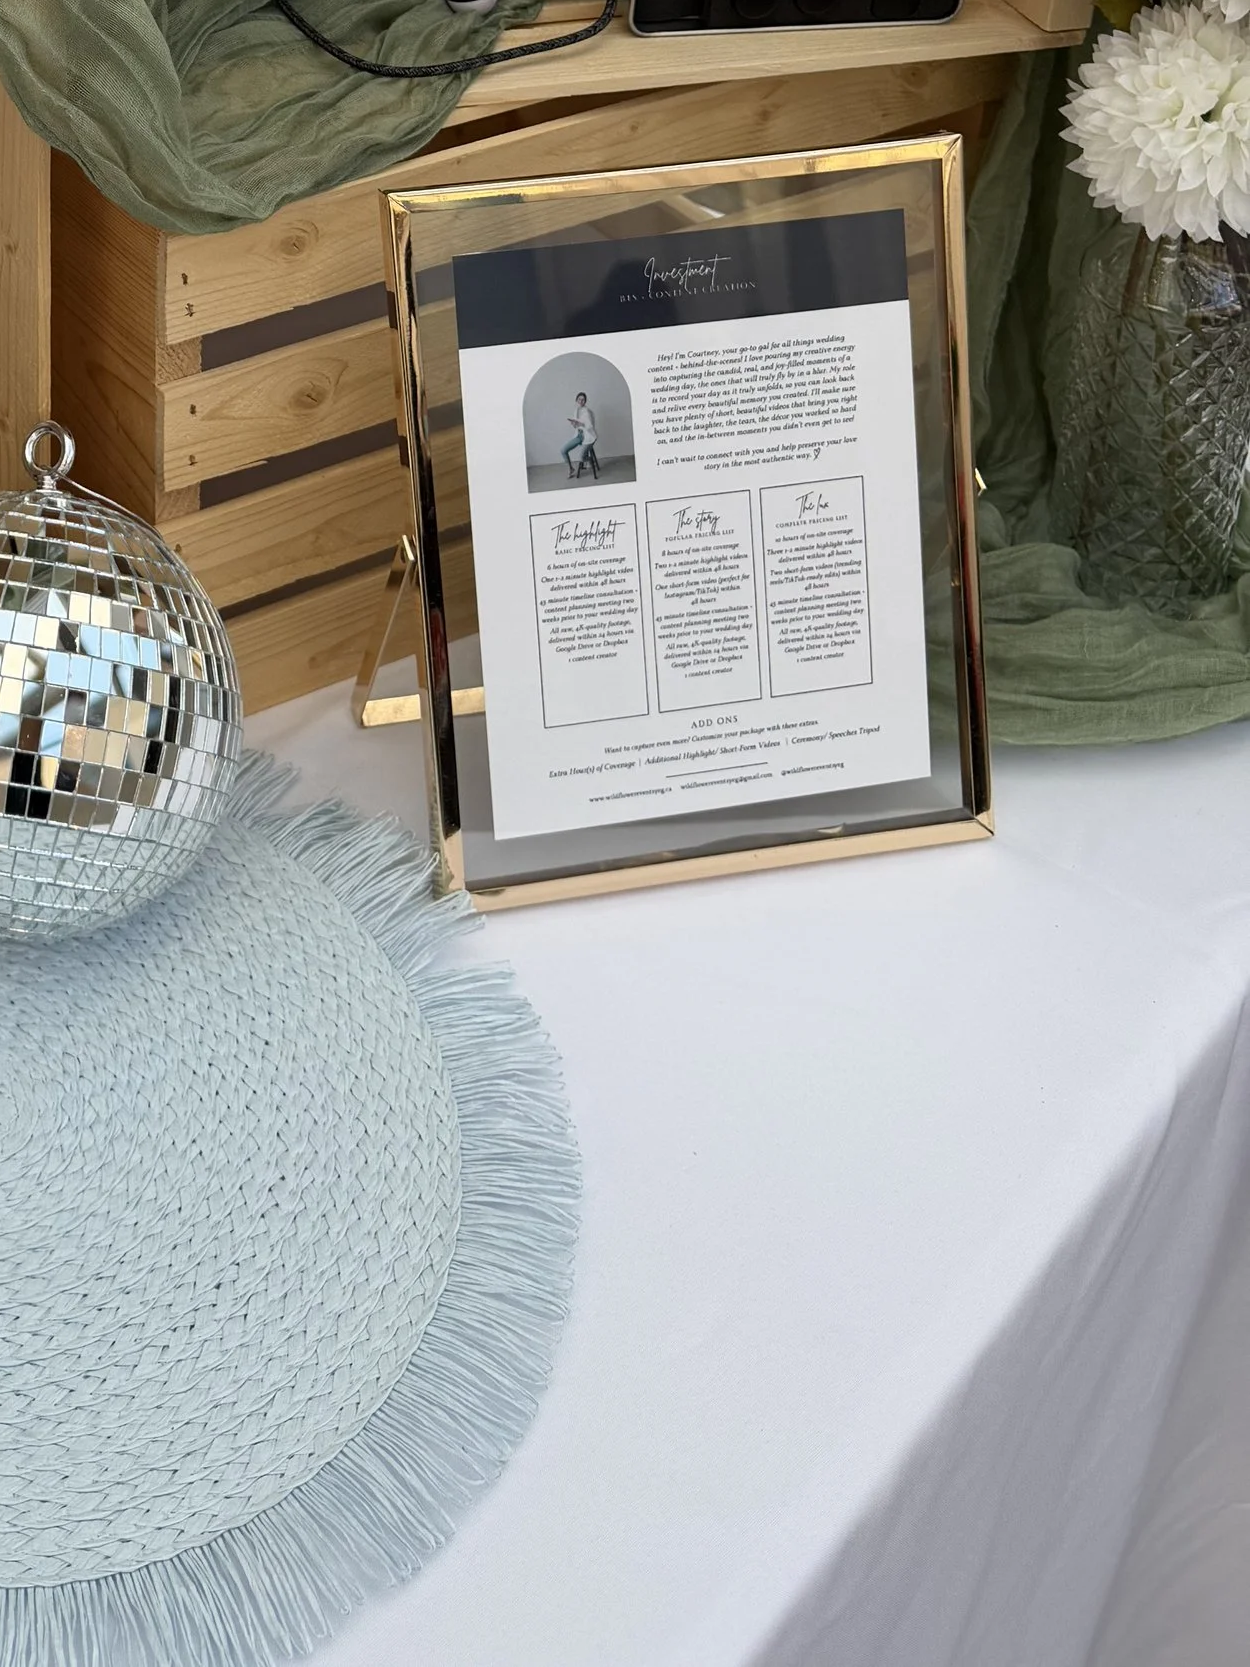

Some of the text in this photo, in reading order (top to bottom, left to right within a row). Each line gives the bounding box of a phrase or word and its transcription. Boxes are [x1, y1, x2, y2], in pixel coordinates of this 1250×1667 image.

[644, 254, 731, 292] Investment
[647, 364, 674, 373] content
[748, 353, 765, 362] love
[763, 350, 793, 362] pouring
[791, 351, 804, 359] my
[804, 346, 832, 355] creative
[832, 345, 856, 354] energy
[721, 348, 739, 357] your
[757, 343, 770, 353] gal
[770, 342, 782, 351] for
[781, 340, 792, 348] all
[791, 339, 815, 349] things
[815, 336, 846, 346] wedding
[650, 384, 681, 395] wedding
[697, 380, 711, 388] the
[727, 377, 744, 385] that
[744, 375, 759, 383] will
[757, 373, 777, 383] truly
[776, 372, 787, 381] fly
[829, 366, 842, 374] My
[841, 364, 856, 372] role
[668, 371, 703, 383] capturing
[703, 369, 716, 377] the
[759, 363, 775, 371] and
[805, 356, 838, 366] moments
[652, 406, 667, 415] and
[666, 404, 687, 413] relive
[687, 403, 707, 412] every
[706, 398, 740, 410] beautiful
[739, 396, 768, 406] memory
[768, 395, 783, 403] you
[782, 390, 810, 399] created.
[821, 386, 842, 395] make
[667, 393, 691, 402] record
[689, 393, 707, 401] your
[706, 389, 722, 400] day
[738, 386, 757, 396] truly
[793, 381, 807, 390] you
[821, 376, 838, 385] look
[838, 374, 855, 382] back
[651, 419, 665, 427] you
[665, 415, 684, 423] have
[683, 412, 707, 423] plenty
[735, 405, 769, 417] beautiful
[768, 402, 791, 411] videos
[790, 401, 807, 409] that
[806, 398, 826, 408] bring
[826, 398, 840, 406] you
[840, 395, 858, 405] right
[795, 491, 815, 519] The
[551, 519, 626, 548] The highlight
[673, 506, 720, 535] The story
[691, 716, 738, 728] ADD ONS
